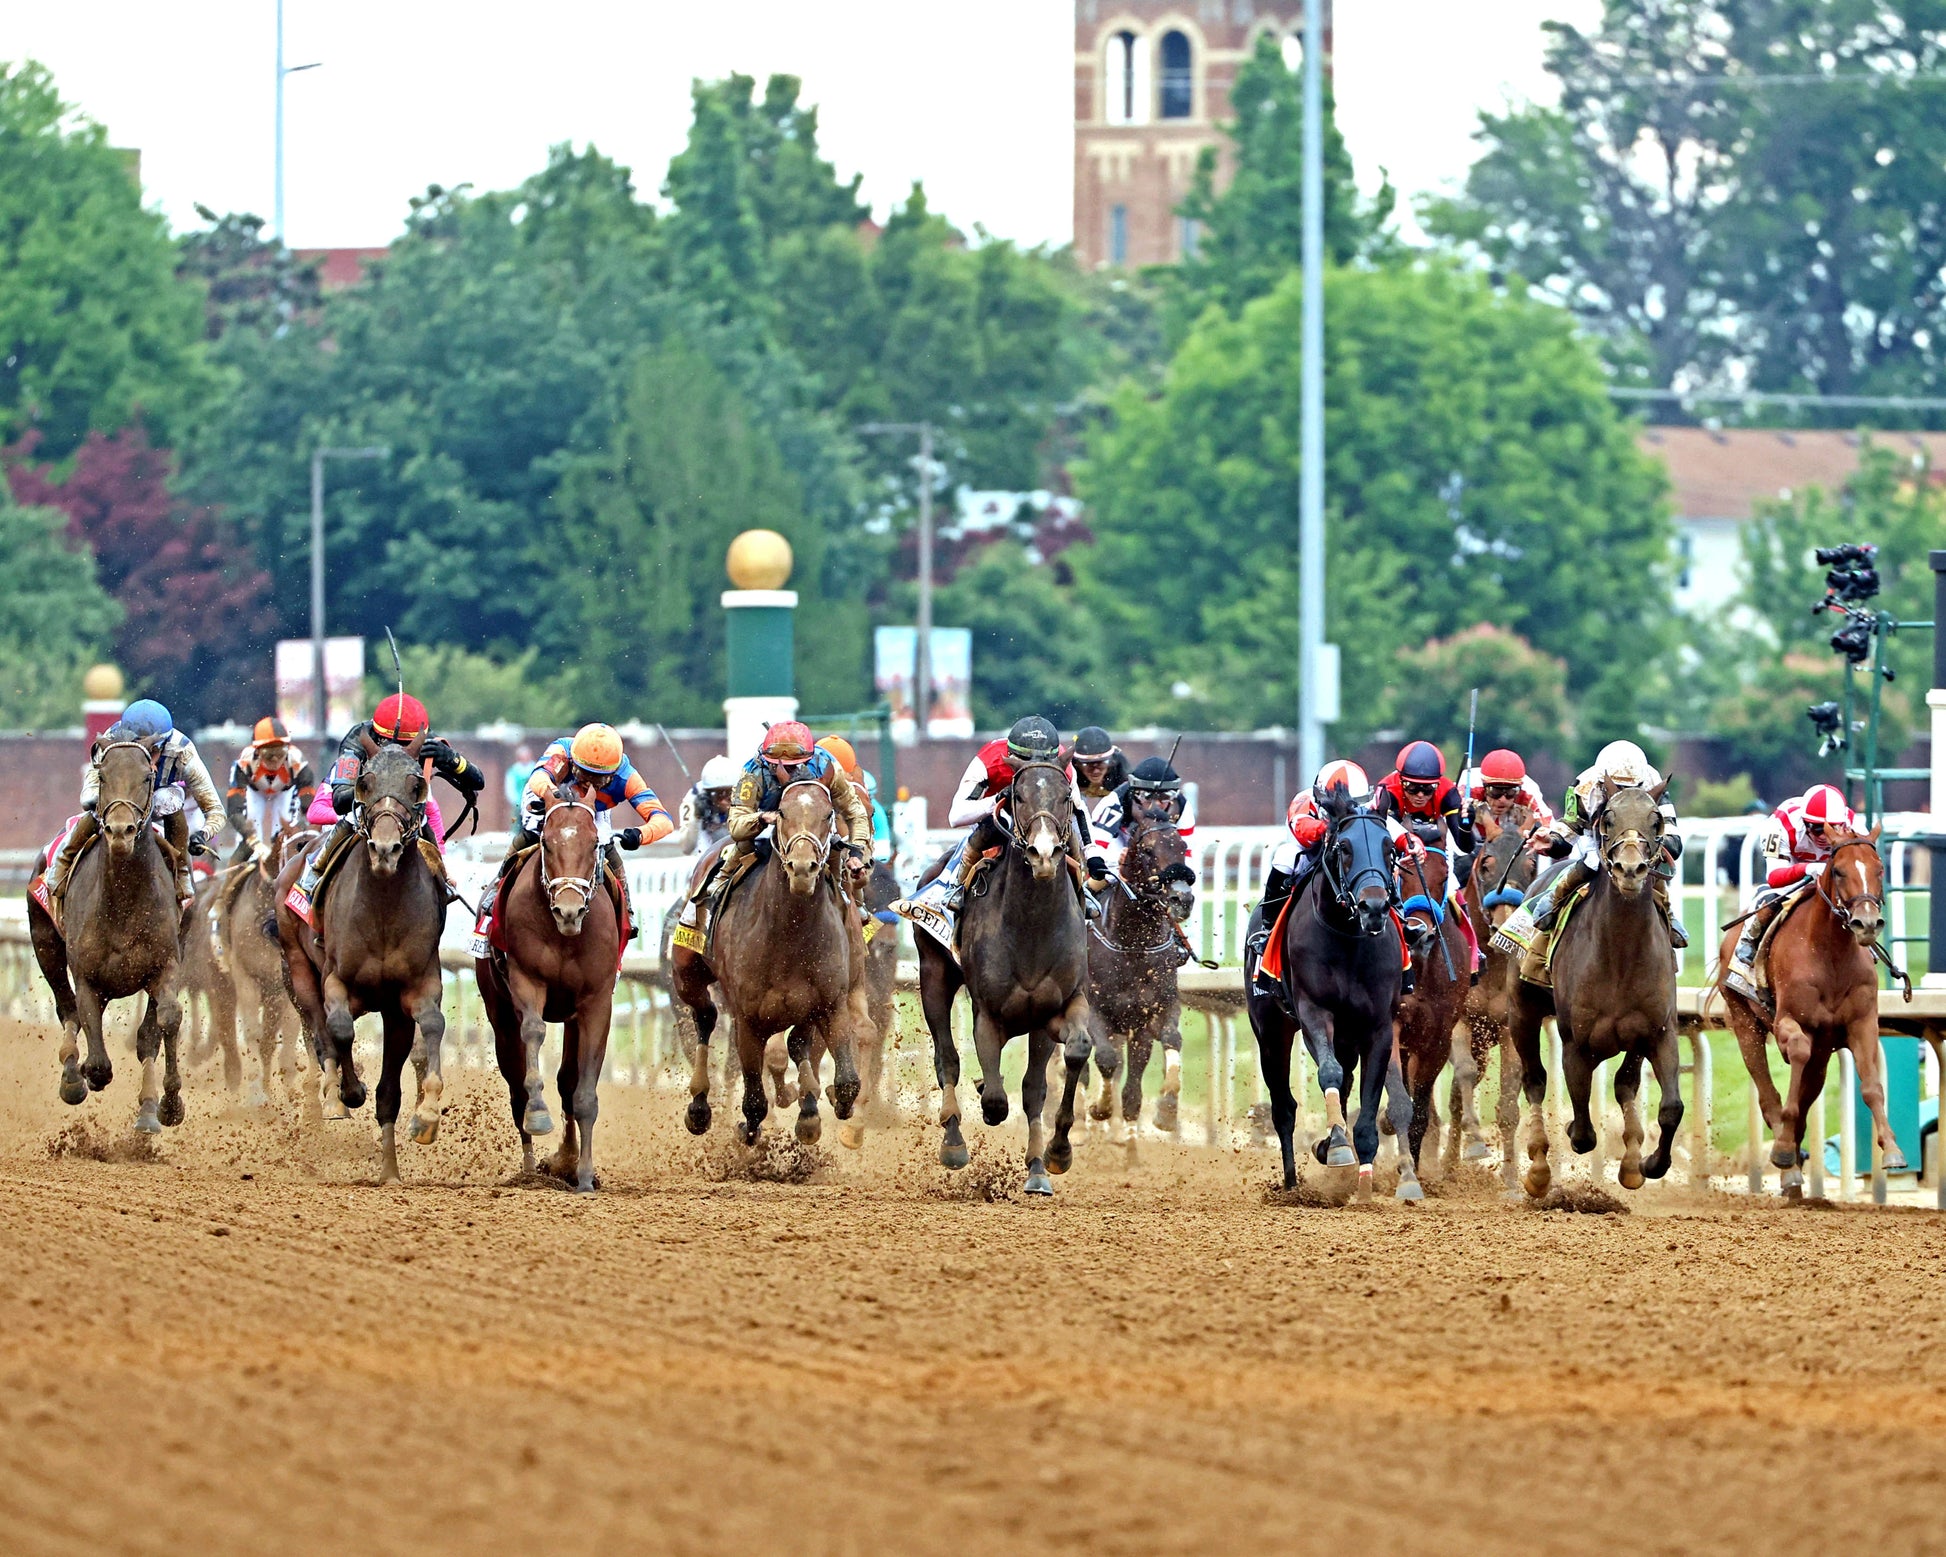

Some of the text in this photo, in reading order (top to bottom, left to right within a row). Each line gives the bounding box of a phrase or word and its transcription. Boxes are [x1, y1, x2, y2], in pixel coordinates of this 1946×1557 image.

[337, 757, 360, 780] 19
[740, 781, 754, 800] 6
[1099, 807, 1123, 828] 17
[1765, 833, 1779, 853] 15
